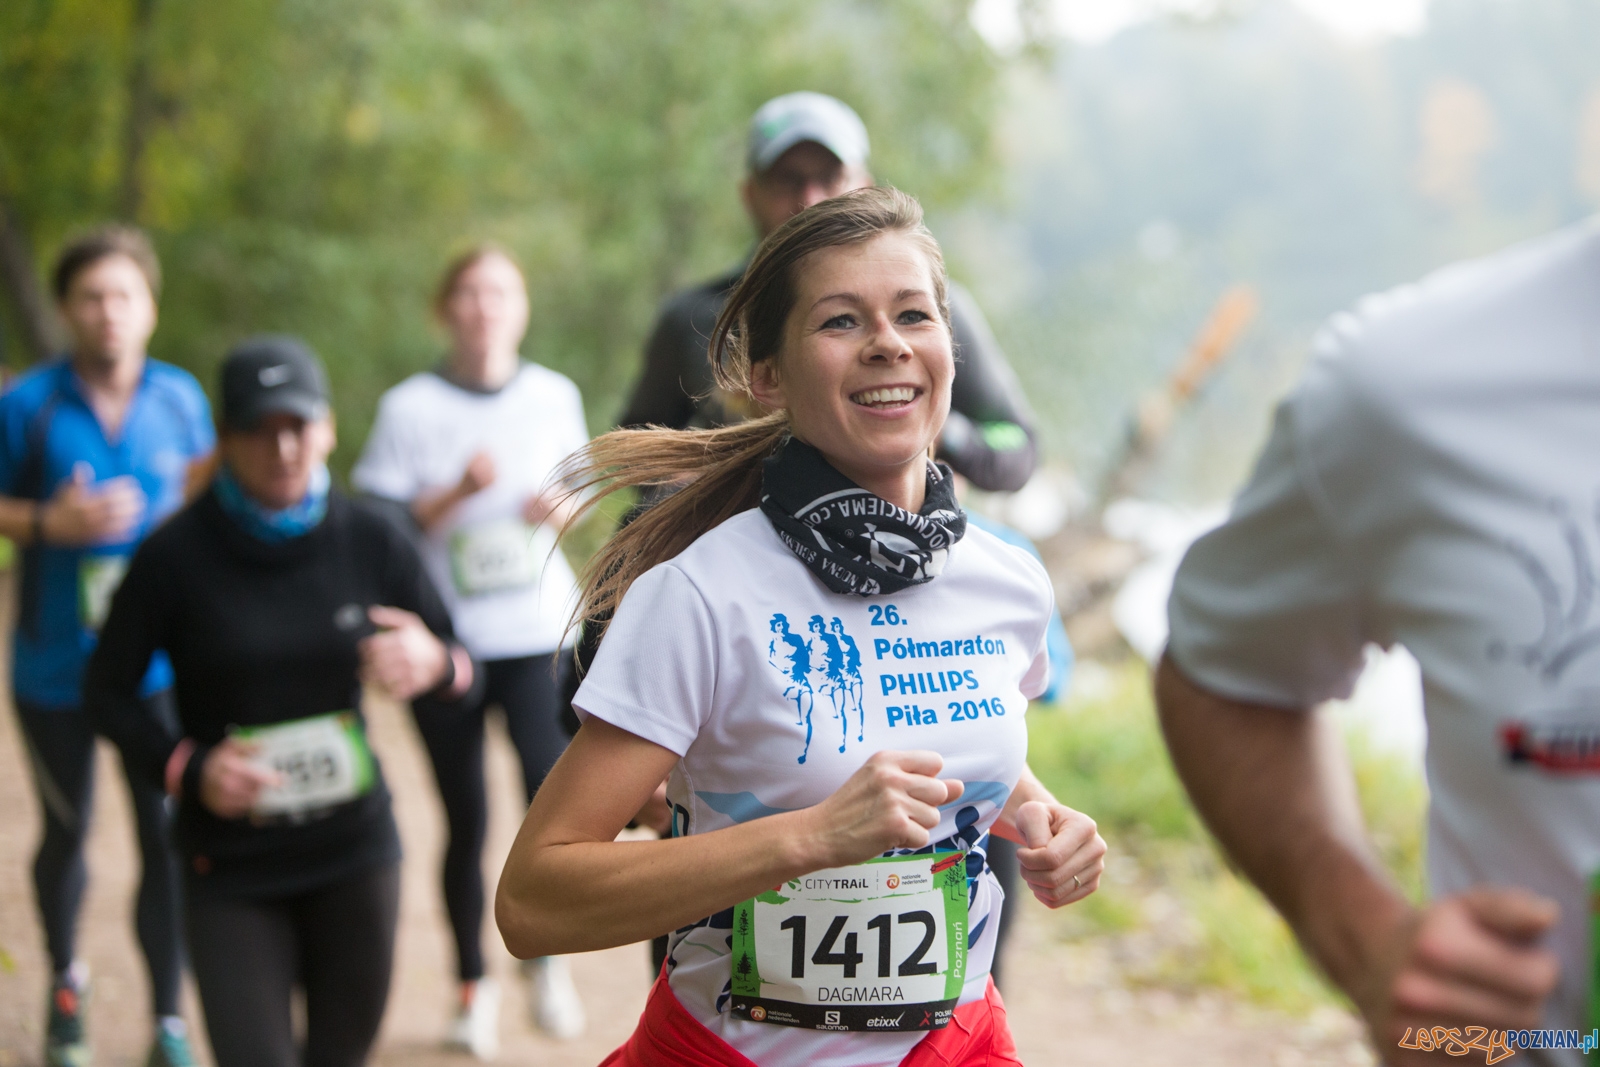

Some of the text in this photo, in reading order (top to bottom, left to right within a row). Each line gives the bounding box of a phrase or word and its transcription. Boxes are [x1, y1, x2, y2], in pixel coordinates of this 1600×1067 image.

[868, 604, 908, 626] 26.
[873, 635, 1006, 660] Półmaraton
[879, 669, 979, 696] PHILIPS
[886, 697, 1006, 727] Piła 2016
[780, 910, 938, 978] 1412
[953, 921, 963, 978] Poznań
[818, 986, 905, 1002] DAGMARA
